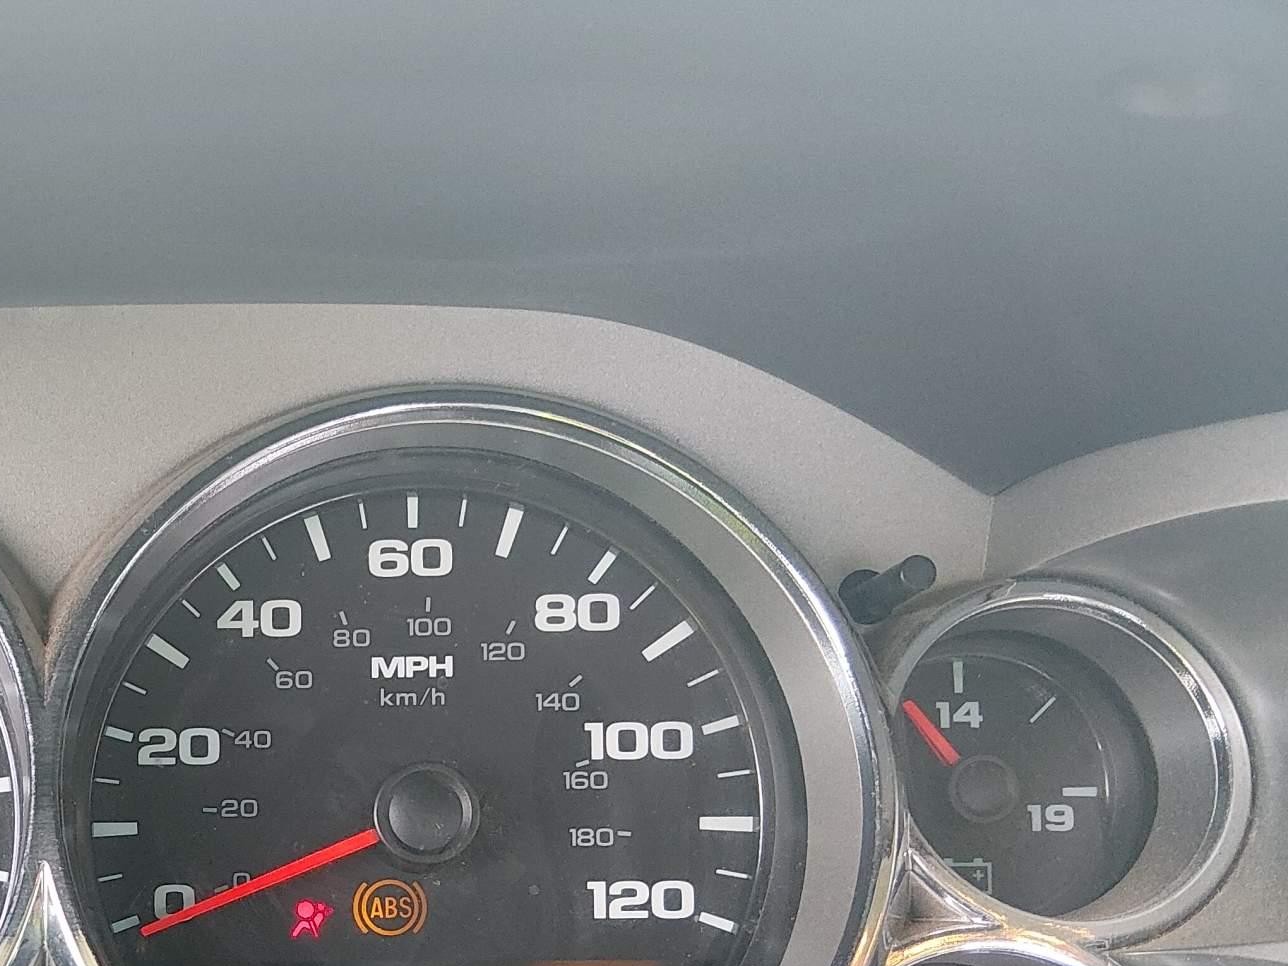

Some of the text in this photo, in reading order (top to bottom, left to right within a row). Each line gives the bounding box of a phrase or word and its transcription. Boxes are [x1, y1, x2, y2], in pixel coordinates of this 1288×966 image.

[368, 538, 454, 579] 60
[216, 599, 302, 638] 40
[534, 593, 621, 633] 80
[406, 616, 452, 638] 100
[331, 628, 372, 650] 80
[480, 641, 527, 664] 120
[370, 656, 455, 680] MPH
[274, 669, 314, 692] 60
[379, 688, 447, 708] km/h
[535, 693, 581, 715] 140
[935, 701, 984, 729] 14
[137, 728, 223, 767] 20
[233, 729, 273, 750] 40
[584, 722, 694, 761] 100
[563, 770, 609, 793] 160
[220, 799, 259, 820] 20
[1026, 804, 1075, 832] 19
[569, 828, 615, 850] 180
[153, 884, 196, 921] 0
[370, 897, 414, 919] ABS
[586, 880, 696, 921] 120
